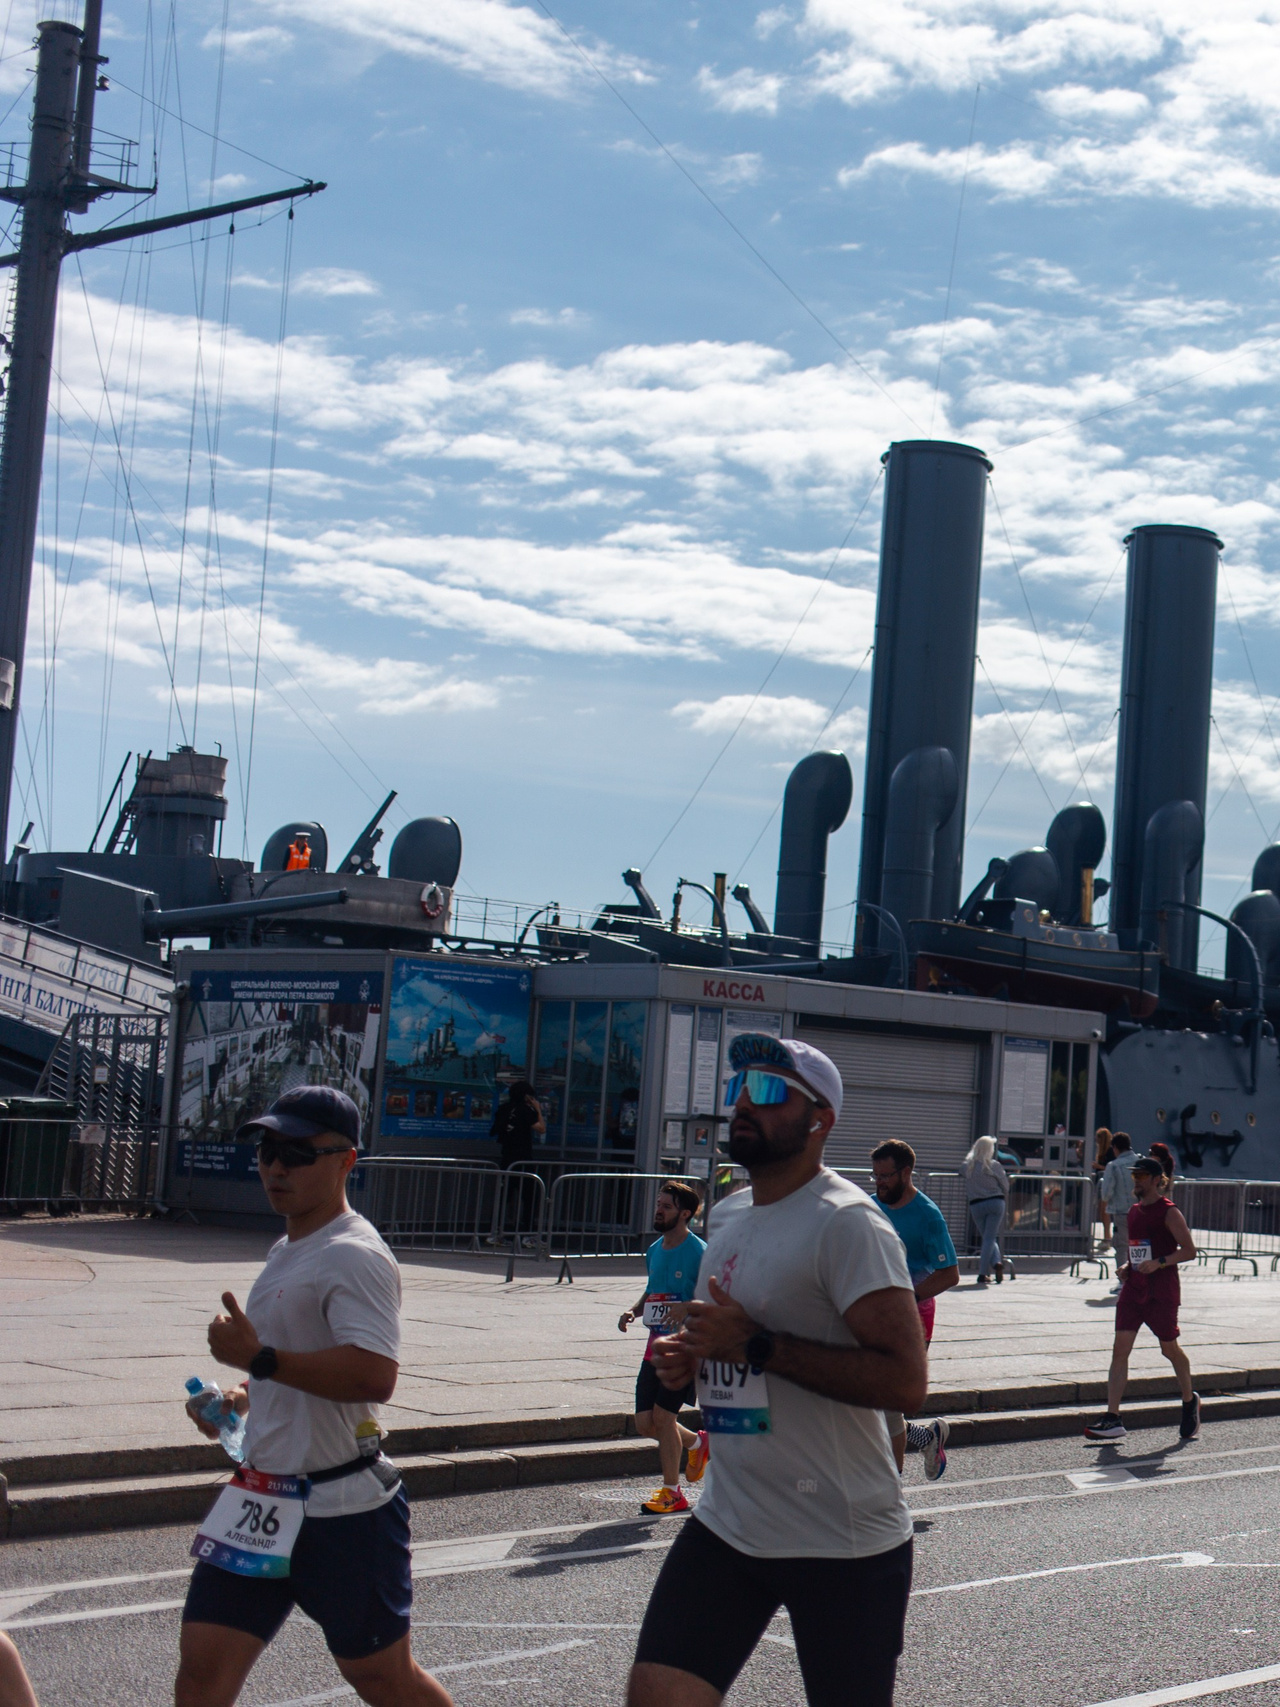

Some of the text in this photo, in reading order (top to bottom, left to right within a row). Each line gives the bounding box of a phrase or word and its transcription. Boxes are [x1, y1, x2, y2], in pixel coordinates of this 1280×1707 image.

[703, 980, 765, 1002] КАССА
[699, 1357, 749, 1388] 4109
[711, 1389, 734, 1401] ЛЕВАН
[267, 1481, 282, 1491] 21,1
[235, 1499, 280, 1536] 786
[224, 1530, 277, 1550] АЛЕКСАНДР
